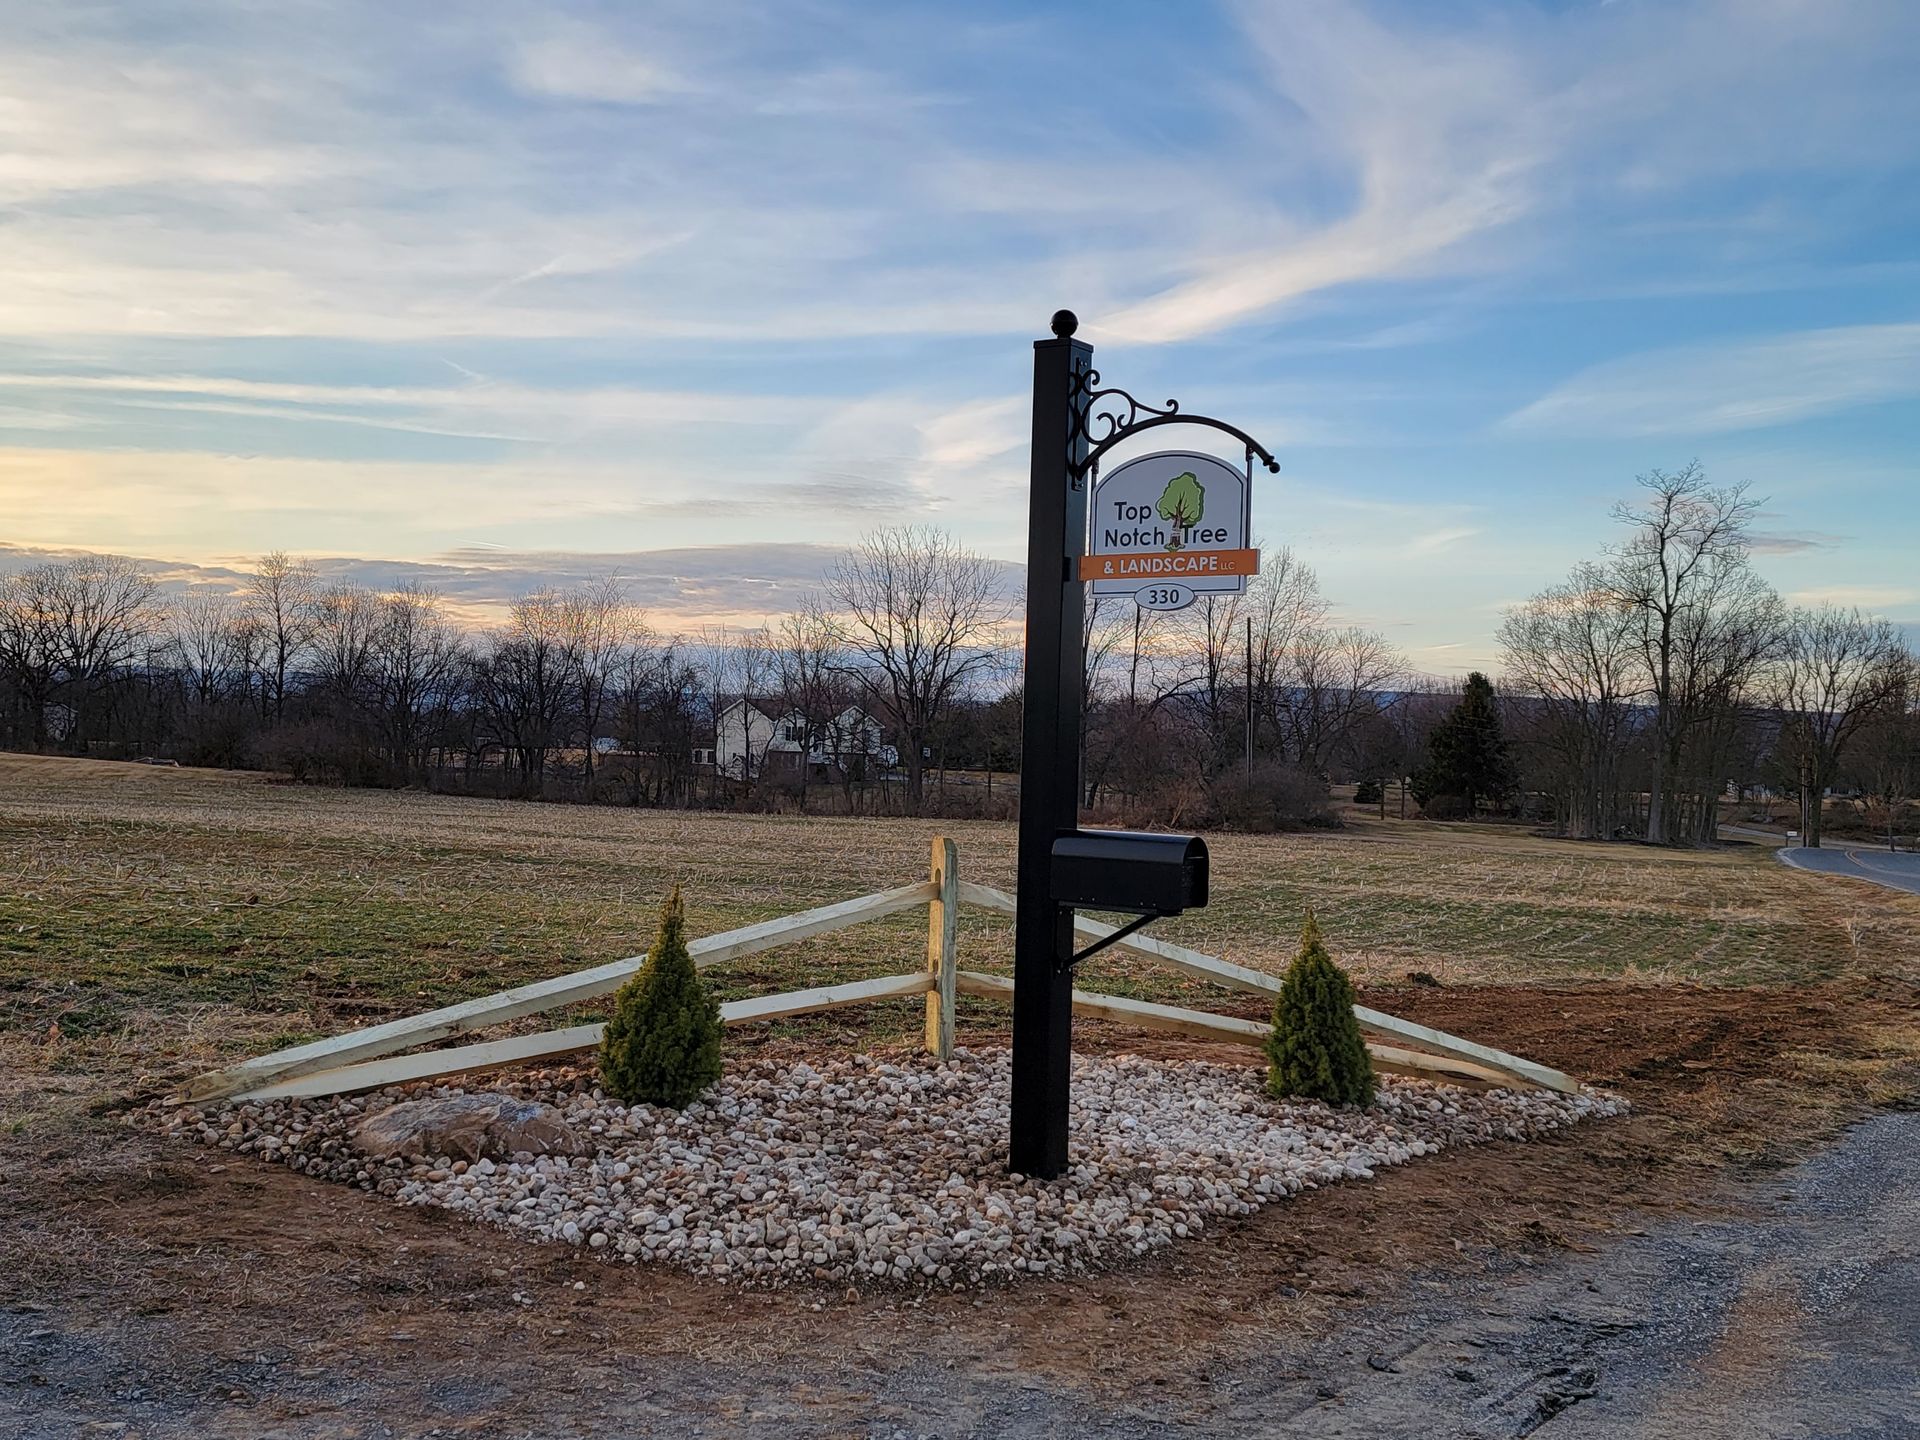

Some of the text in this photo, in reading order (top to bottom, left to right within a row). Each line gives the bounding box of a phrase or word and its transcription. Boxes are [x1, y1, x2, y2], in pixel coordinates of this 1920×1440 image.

[1114, 501, 1152, 524] Top
[1104, 524, 1228, 547] Notch Tree
[1103, 556, 1235, 574] & LANDSCAPE LLC
[1149, 589, 1180, 604] 330
